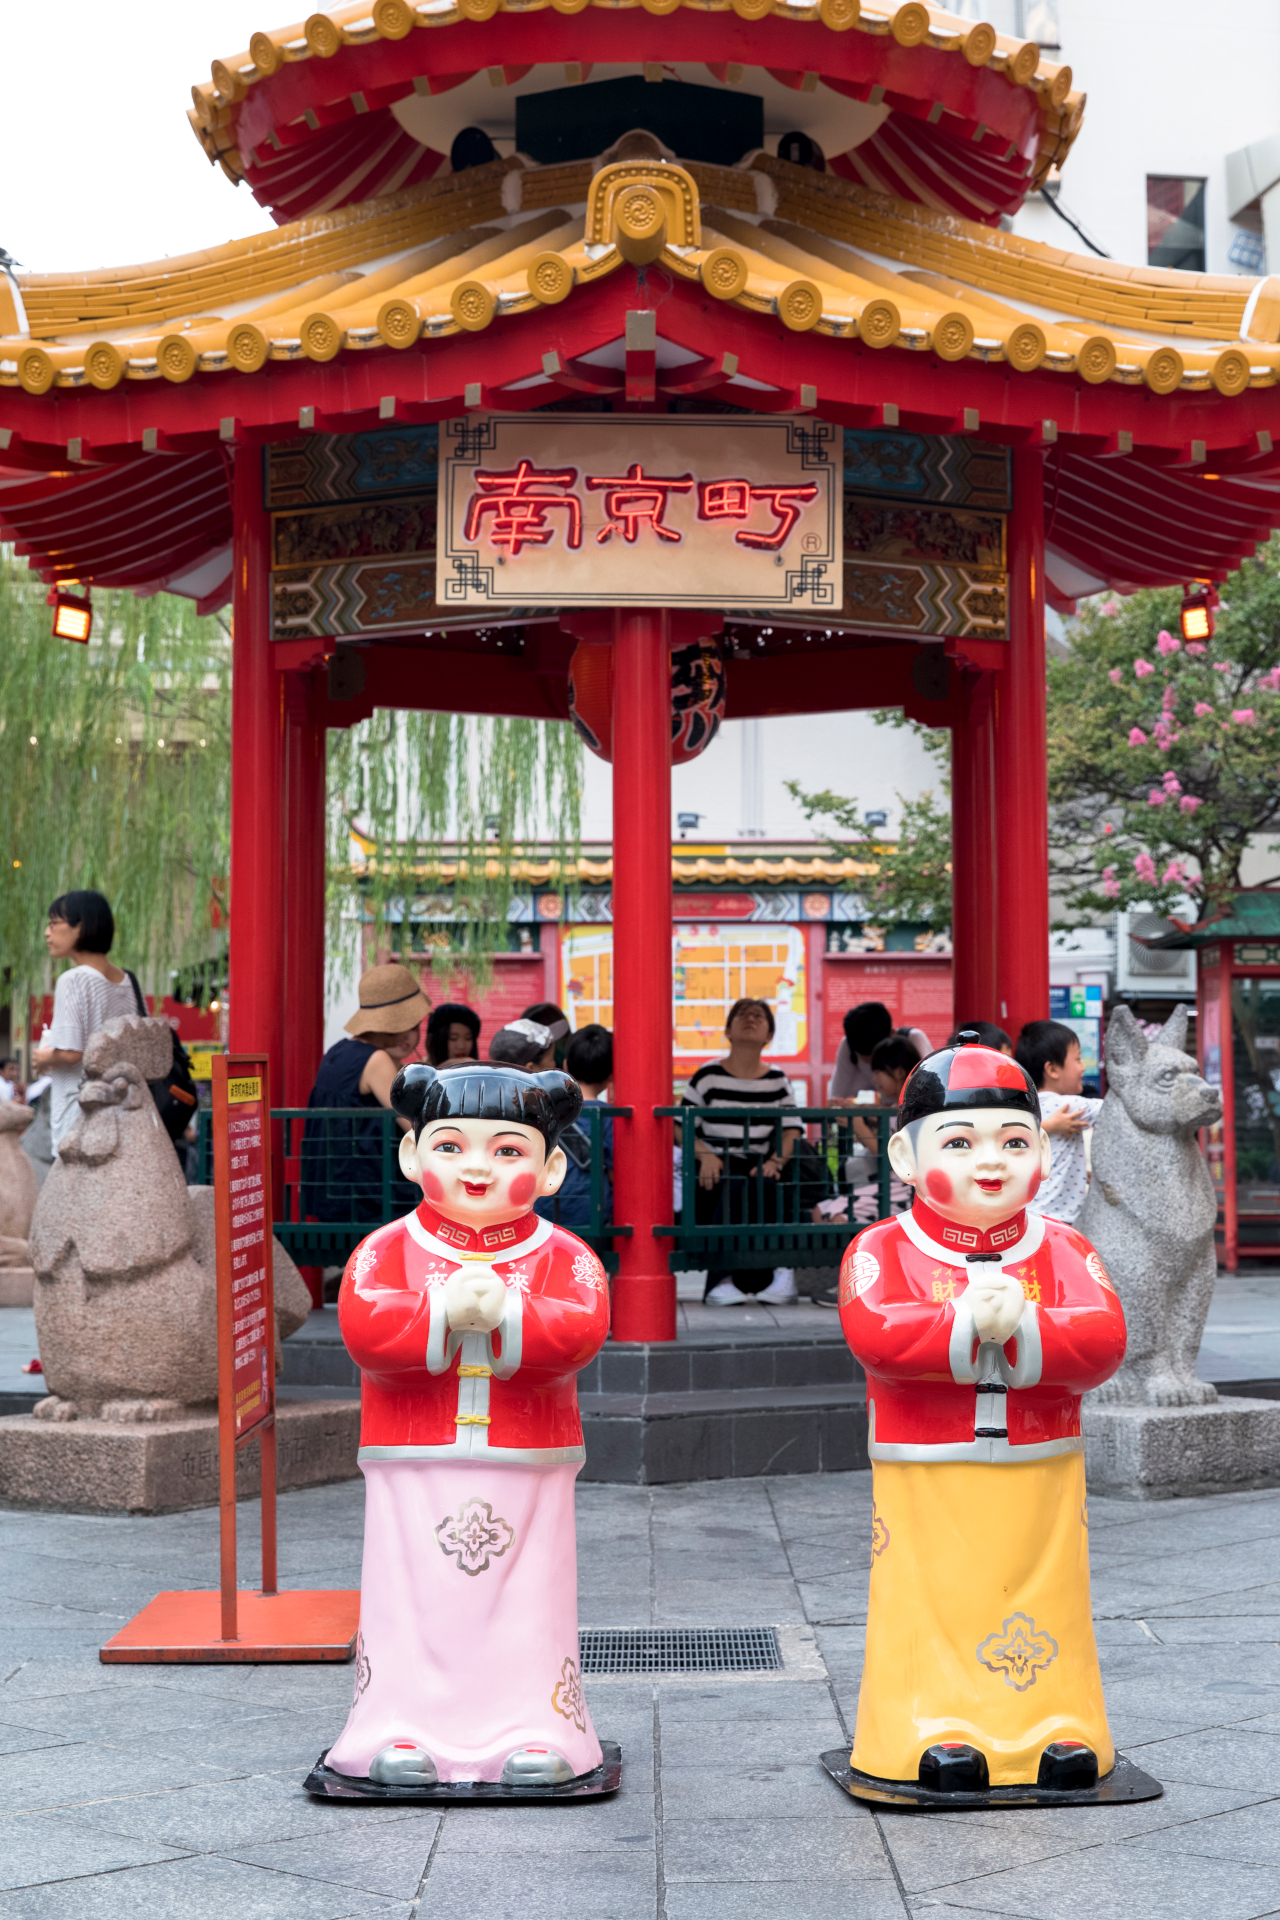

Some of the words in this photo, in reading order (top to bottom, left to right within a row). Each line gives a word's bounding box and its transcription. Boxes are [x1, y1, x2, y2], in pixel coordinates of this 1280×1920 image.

[464, 459, 818, 555] 南京町
[428, 1261, 447, 1270] ライ
[508, 1262, 527, 1270] ライ
[931, 1267, 953, 1278] ザイ
[1017, 1267, 1036, 1277] ザイ
[932, 1280, 957, 1302] 財
